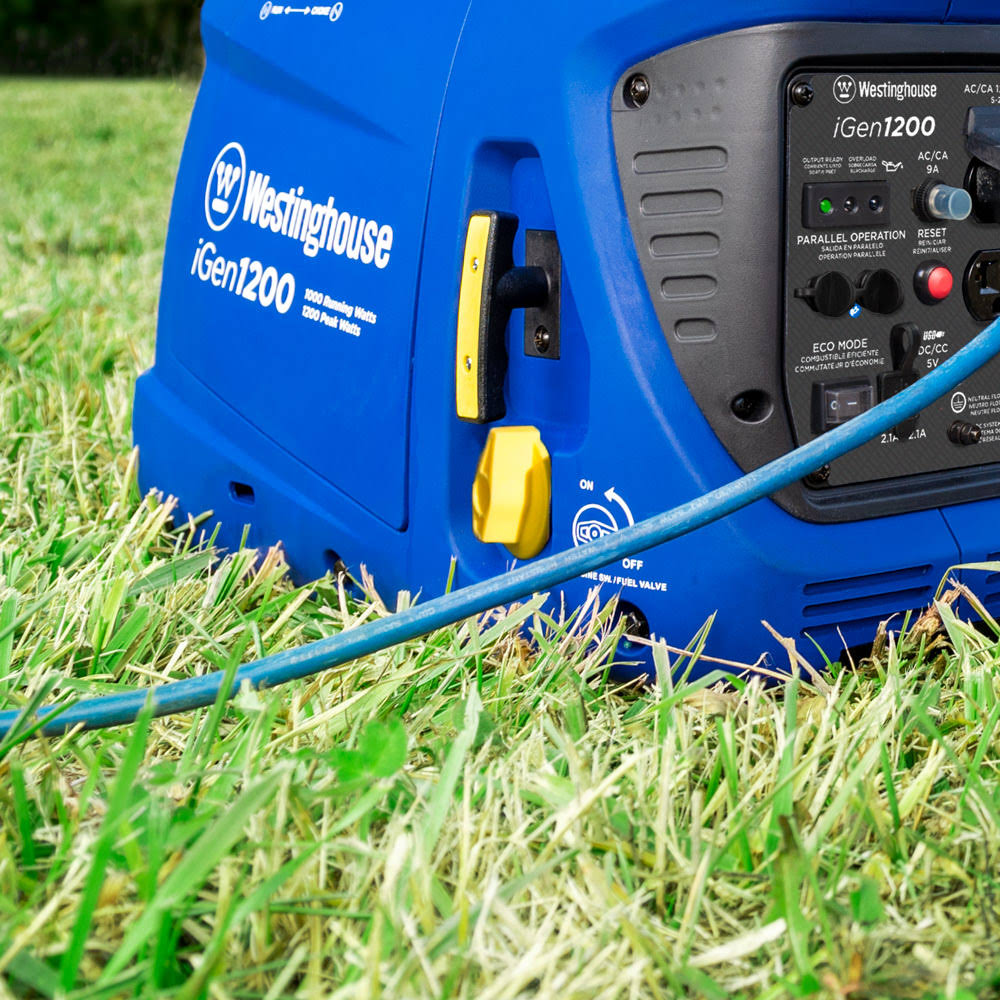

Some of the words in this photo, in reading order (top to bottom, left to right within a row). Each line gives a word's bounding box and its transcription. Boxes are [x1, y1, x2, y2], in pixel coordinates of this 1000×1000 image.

[858, 81, 937, 101] Westinghouse
[964, 83, 993, 95] AC/CA
[832, 116, 936, 138] iGen1200
[917, 150, 949, 162] AC/CA
[926, 164, 940, 174] 9A
[242, 170, 394, 269] Westinghouse
[797, 233, 848, 246] PARALLEL
[850, 230, 906, 243] OPERATION
[917, 228, 947, 239] RESET
[821, 244, 843, 252] SALIDA
[191, 238, 296, 314] iGen1200
[304, 288, 324, 305] 1000
[322, 295, 354, 318] Running
[354, 305, 377, 324] Watts
[302, 305, 321, 322] 1200
[320, 312, 339, 328] Peak
[339, 319, 361, 337] Watts
[812, 341, 835, 353] ECO
[837, 338, 868, 350] MODE
[918, 343, 949, 356] DC/CC
[800, 352, 845, 363] COMBUSTIBLE
[926, 358, 940, 369] 5V
[579, 479, 594, 491] ON
[622, 558, 644, 571] OFF
[616, 576, 638, 588] FUEL
[639, 580, 668, 592] VALVE
